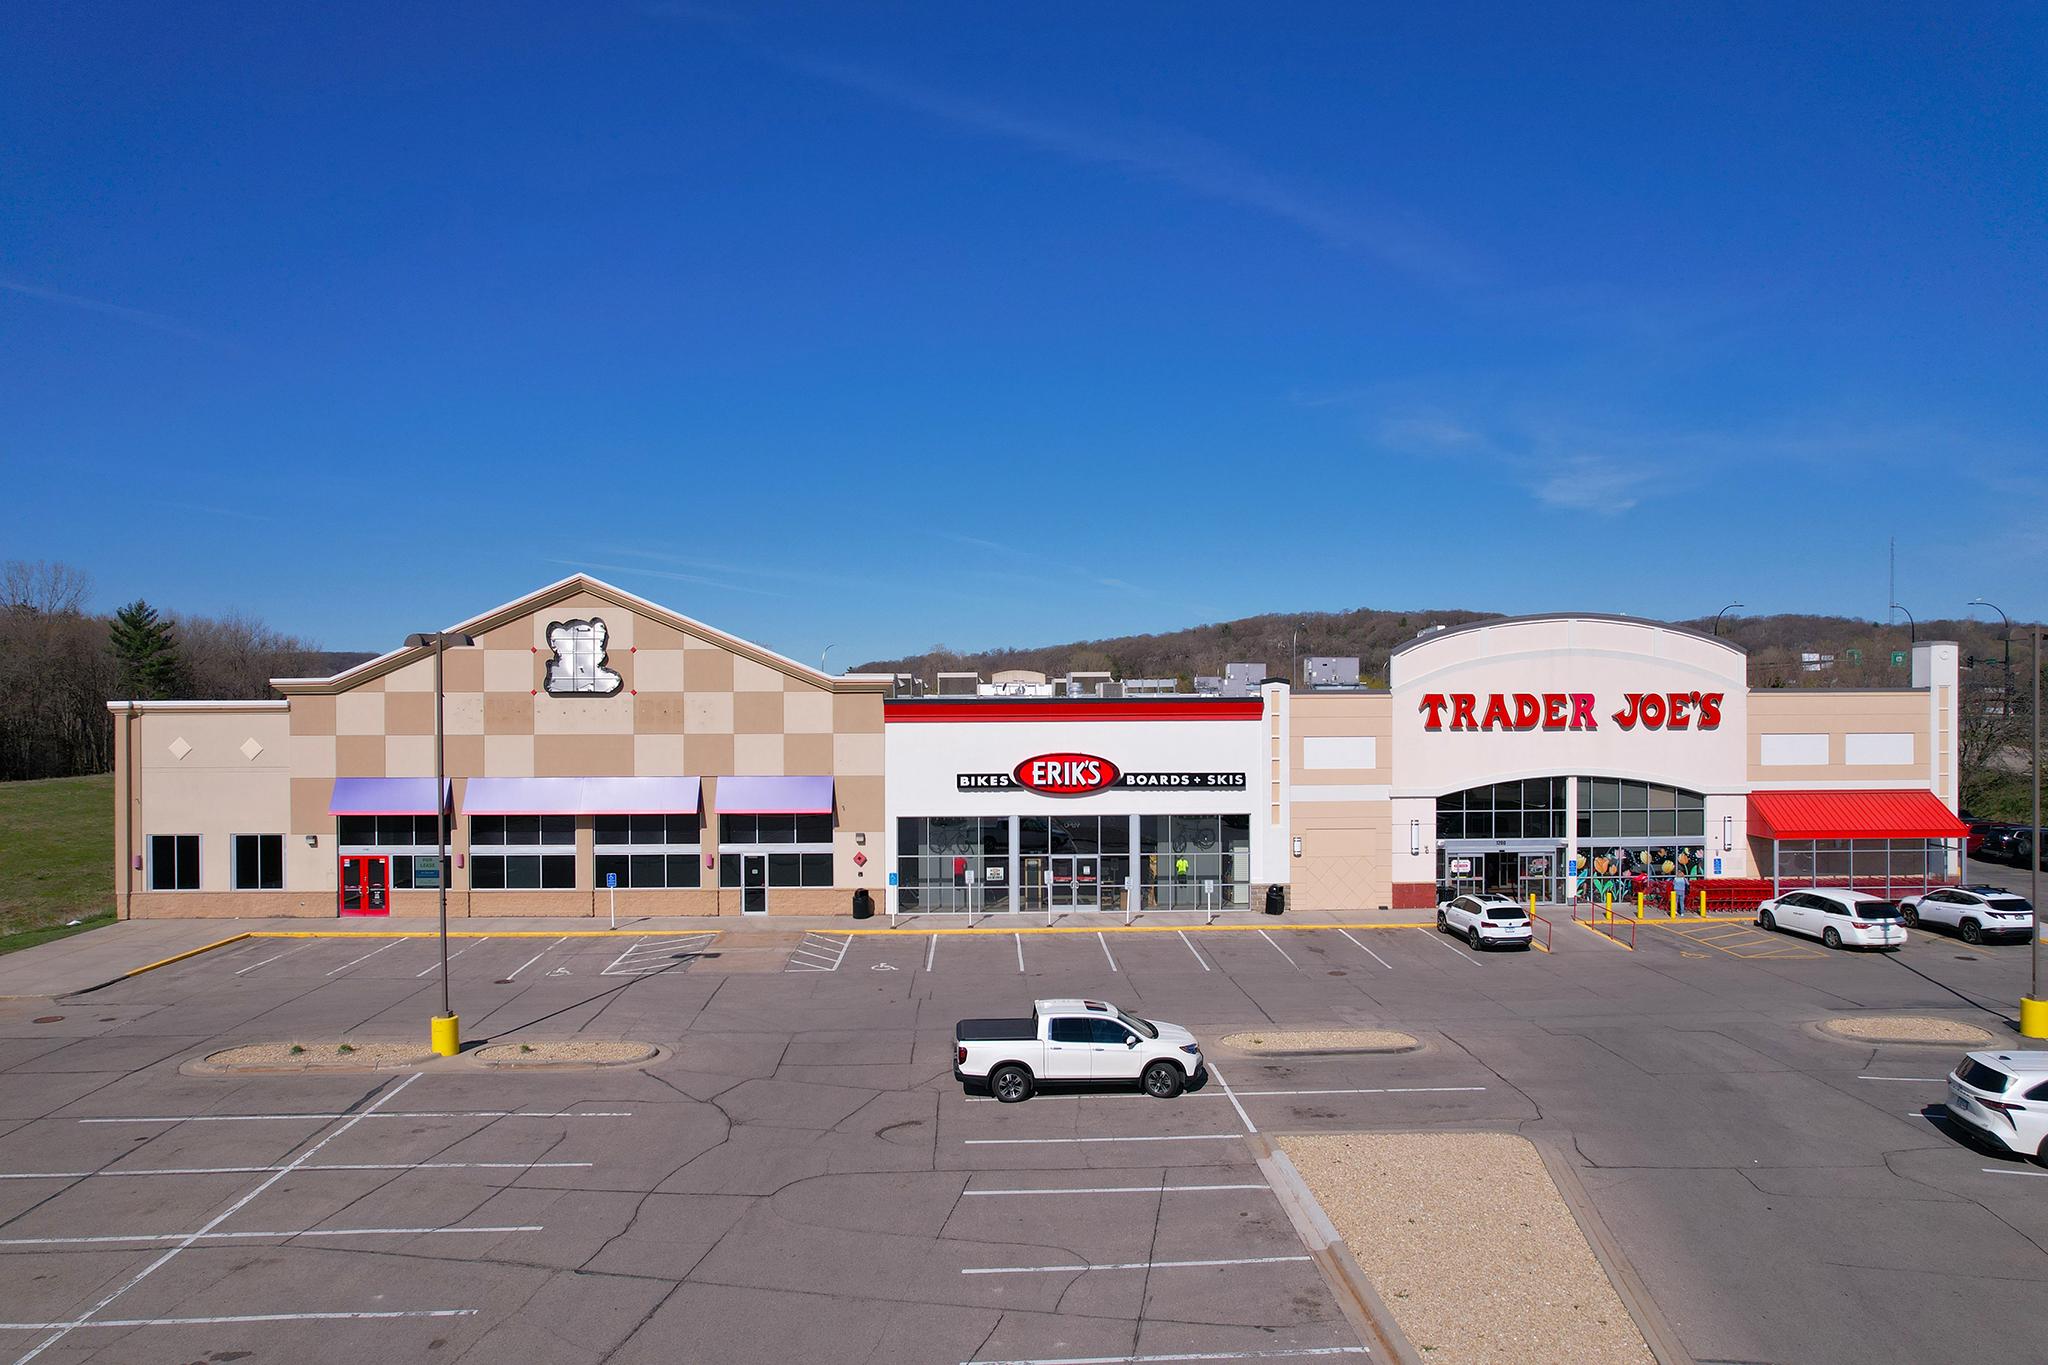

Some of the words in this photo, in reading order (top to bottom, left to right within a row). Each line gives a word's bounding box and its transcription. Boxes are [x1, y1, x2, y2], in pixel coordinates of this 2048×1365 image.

[1418, 692, 1599, 731] TRADER
[1611, 690, 1725, 731] JOE'S
[959, 775, 1009, 787] BIKES
[1032, 760, 1101, 786] ERIK'S
[1126, 774, 1190, 786] BOARDS
[1207, 774, 1244, 786] SKIS
